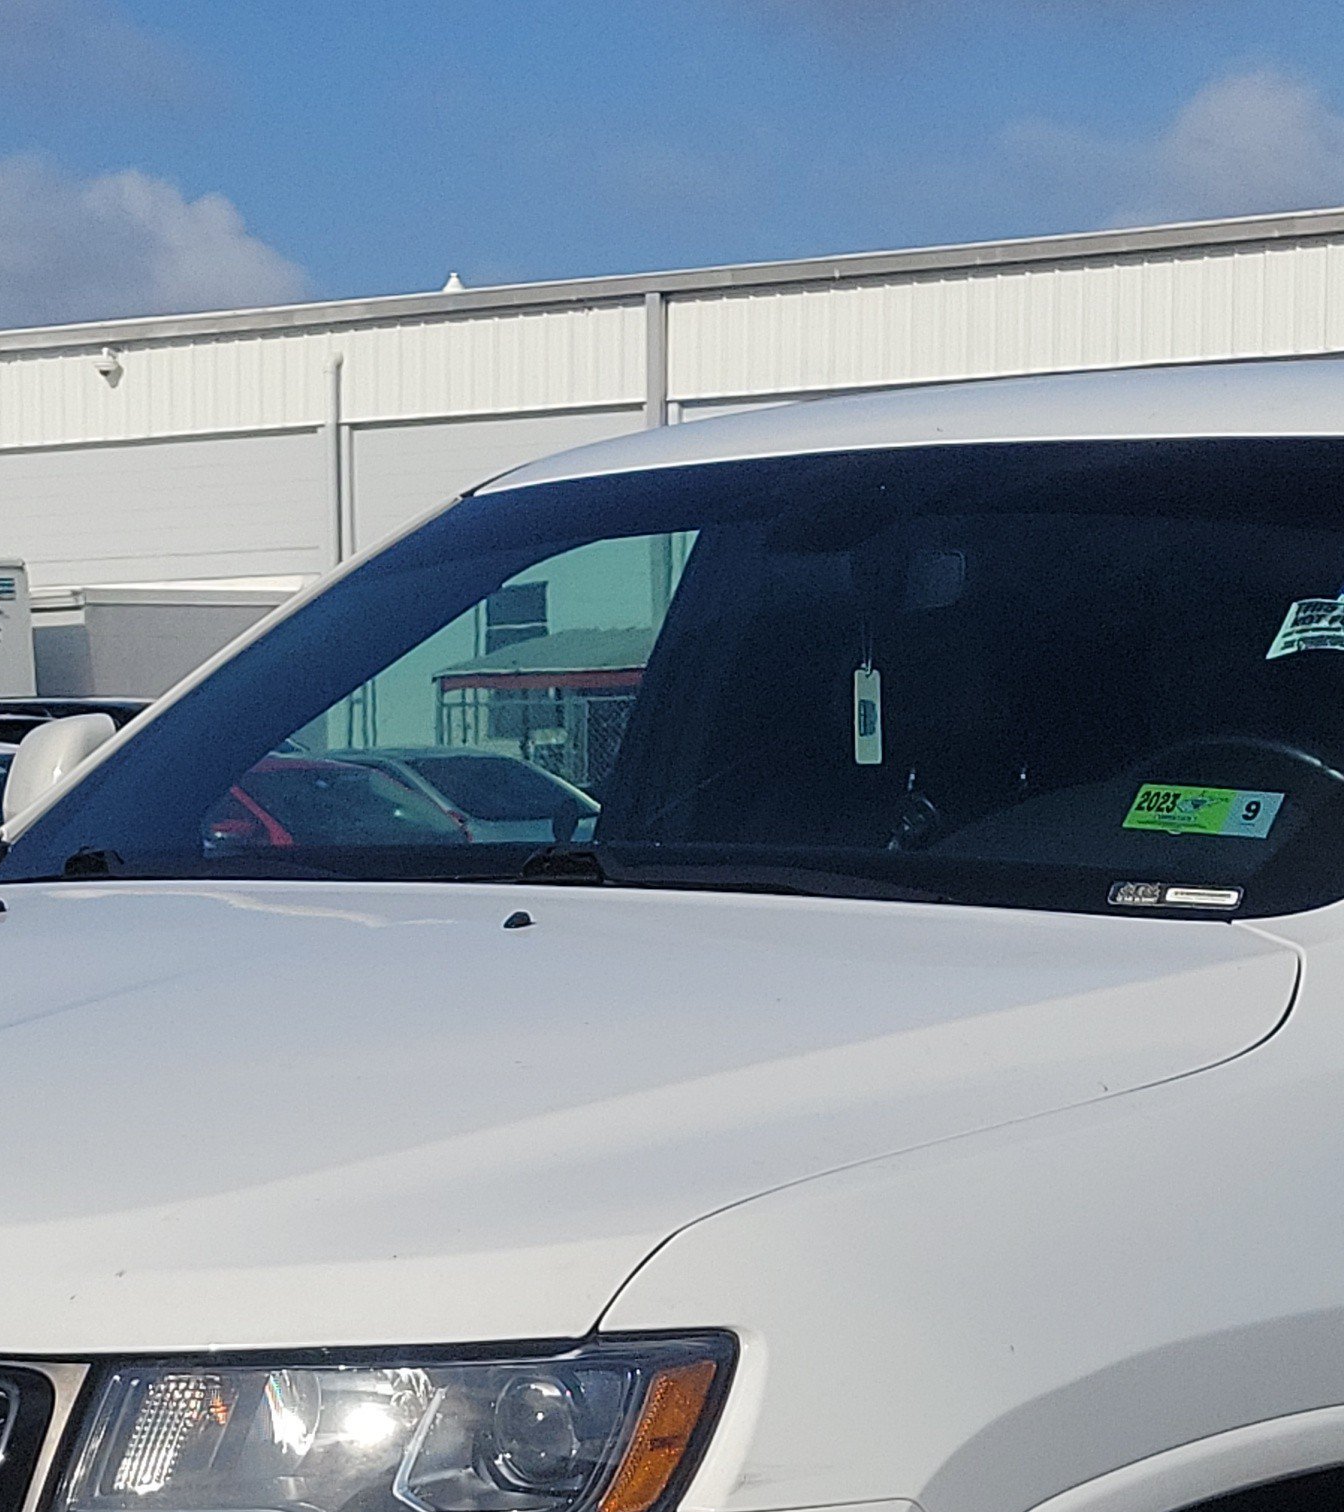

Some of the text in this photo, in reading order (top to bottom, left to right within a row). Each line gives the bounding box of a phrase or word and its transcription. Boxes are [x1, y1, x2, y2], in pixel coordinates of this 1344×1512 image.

[1295, 602, 1339, 615] THIS
[1290, 614, 1329, 628] NOT
[1135, 790, 1181, 813] 2023
[1241, 800, 1261, 821] 9
